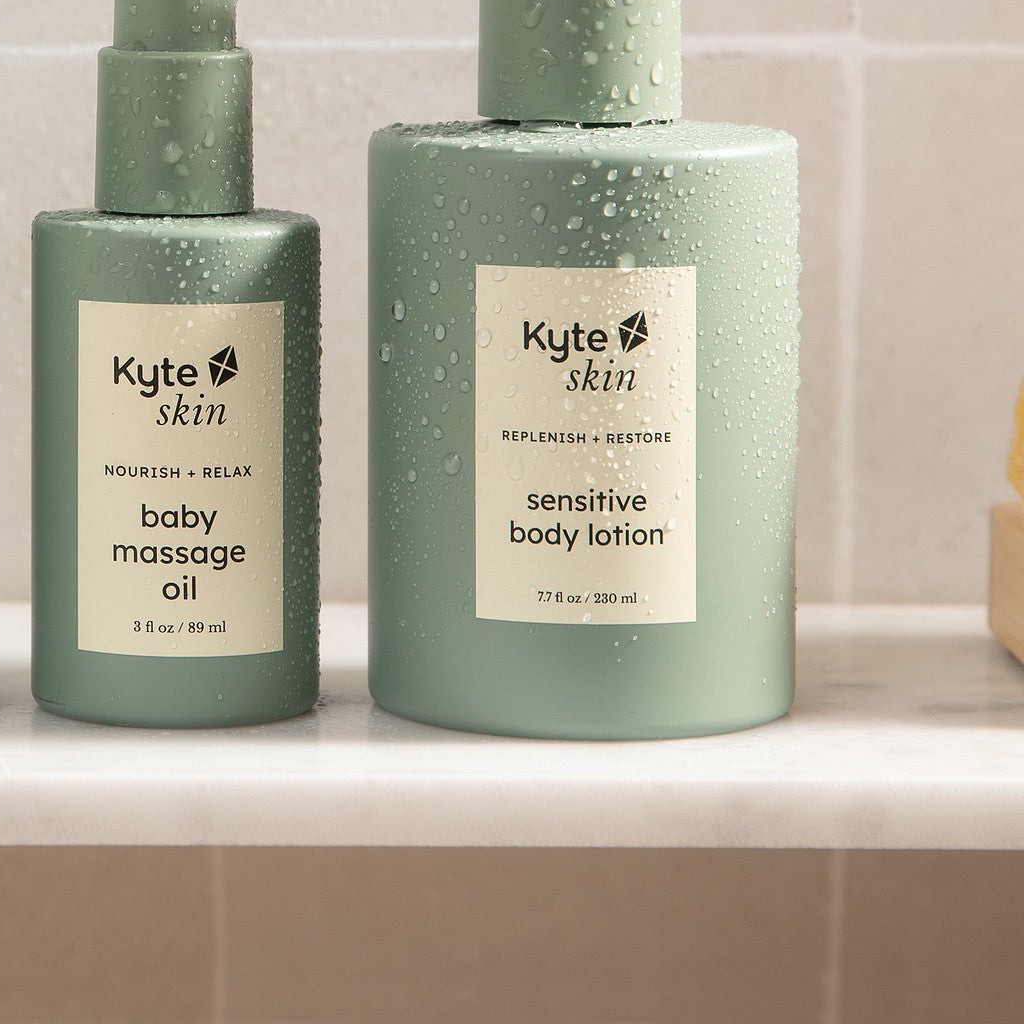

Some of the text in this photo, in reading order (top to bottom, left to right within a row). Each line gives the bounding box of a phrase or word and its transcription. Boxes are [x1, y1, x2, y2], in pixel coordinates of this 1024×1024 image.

[523, 320, 609, 364] Kyte
[113, 355, 199, 399] Kyte
[565, 358, 637, 393] skin
[155, 392, 228, 426] skin
[502, 429, 672, 445] REPLENISH + RESTORE
[104, 464, 253, 479] NOURISH + RELAX
[526, 487, 648, 513] sensitive
[141, 503, 218, 536] baby
[510, 519, 664, 553] body lotion
[112, 544, 246, 571] massage
[161, 574, 197, 601] oil
[537, 590, 637, 605] 7.7 fl oz / 230 ml
[133, 620, 227, 634] 3 fl oz / 89 ml
